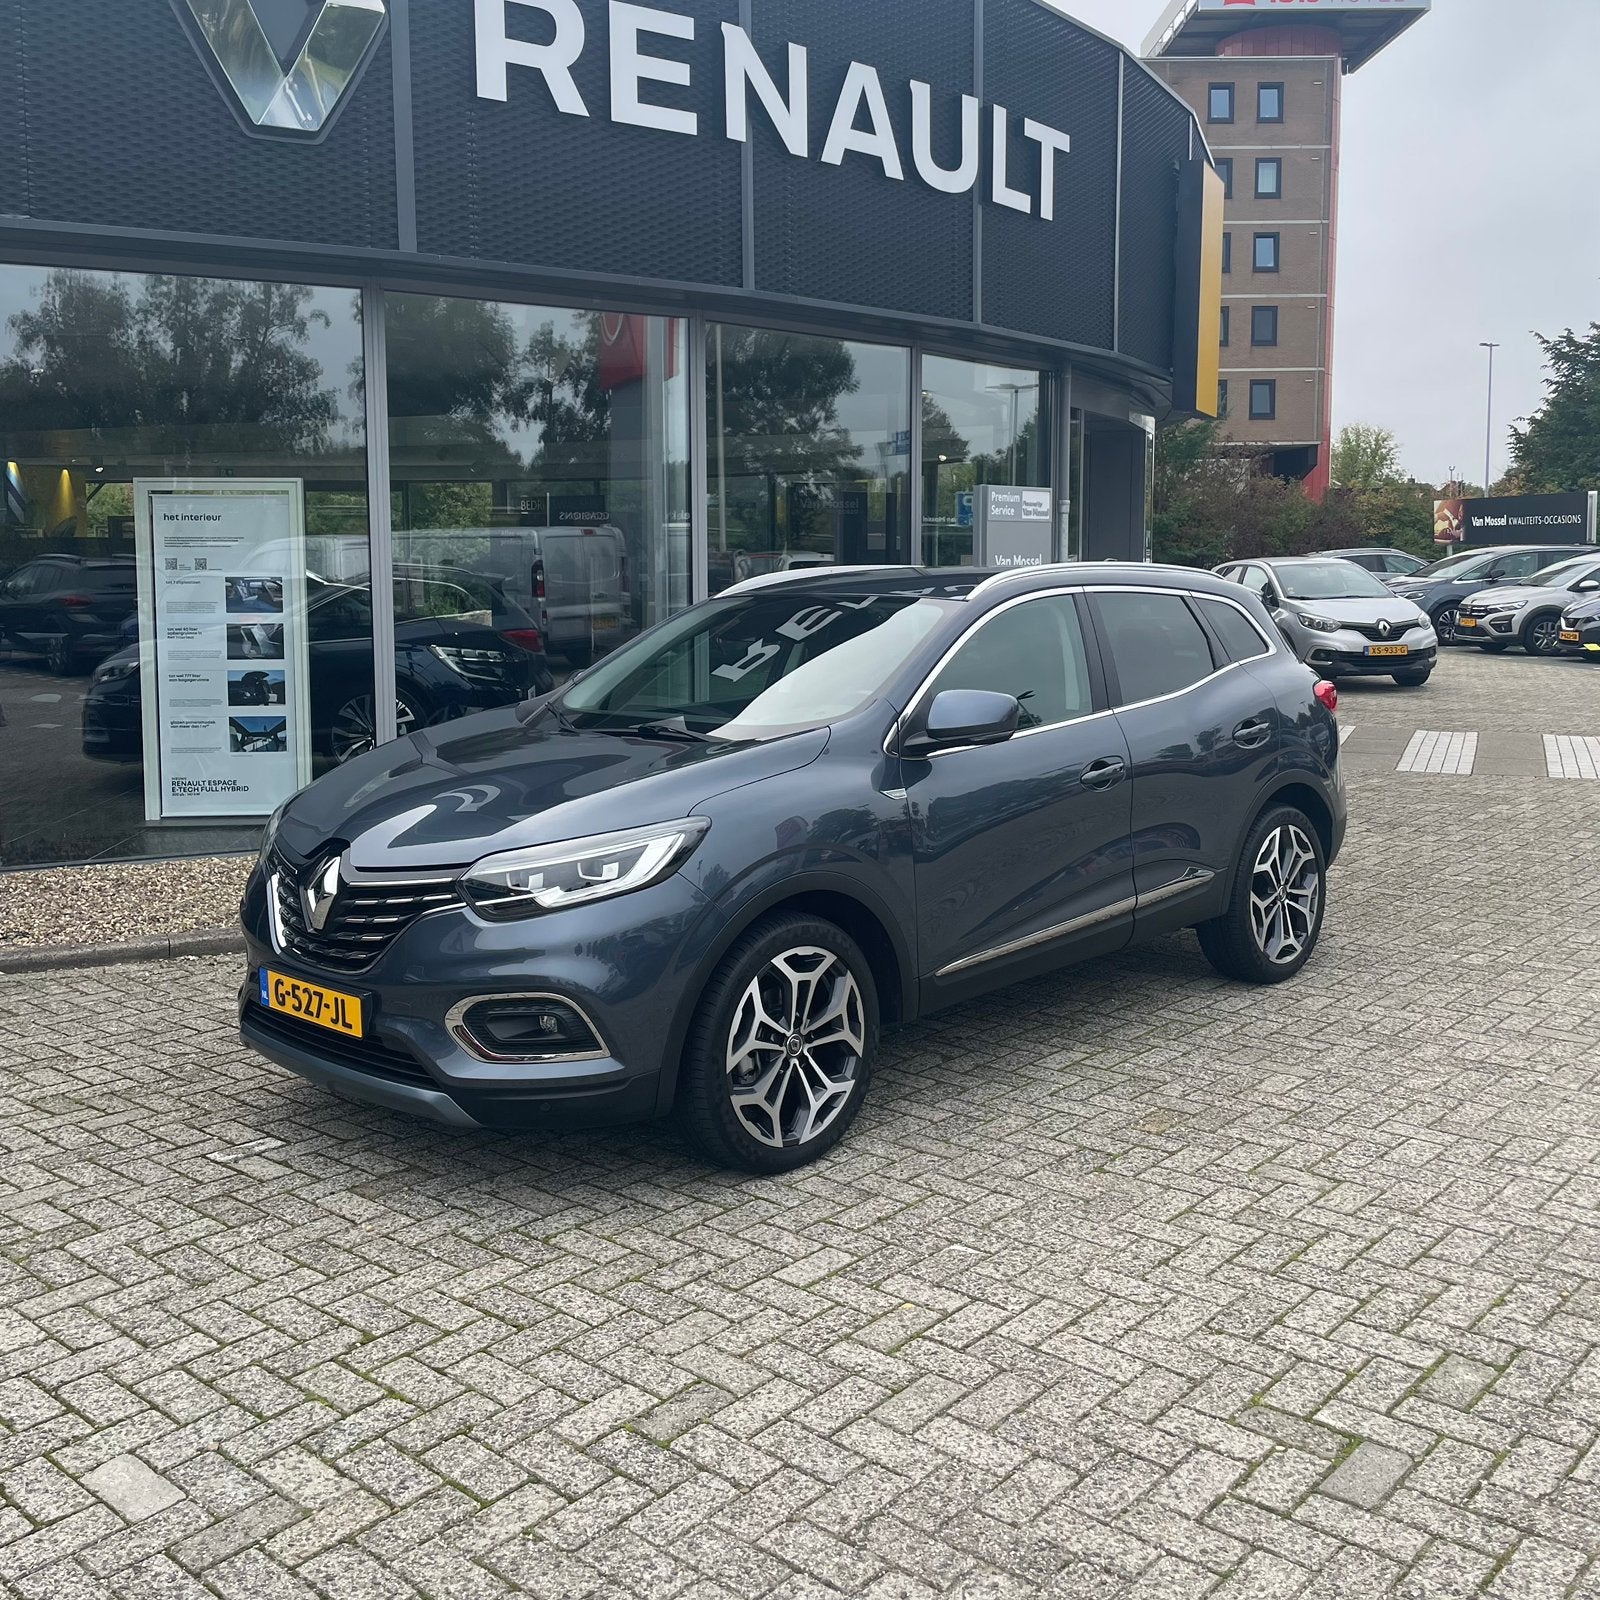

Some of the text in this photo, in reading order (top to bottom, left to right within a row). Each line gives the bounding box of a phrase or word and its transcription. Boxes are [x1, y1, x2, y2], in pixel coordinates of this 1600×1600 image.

[474, 0, 1071, 221] RENAULT
[991, 491, 1020, 503] Premium
[991, 505, 1015, 516] Service
[163, 513, 222, 521] het interieur
[1472, 514, 1582, 526] Van Mossel KWALITEITS-OCCASIONS
[995, 553, 1042, 566] Van Mossel
[275, 979, 353, 1029] G-527-JL
